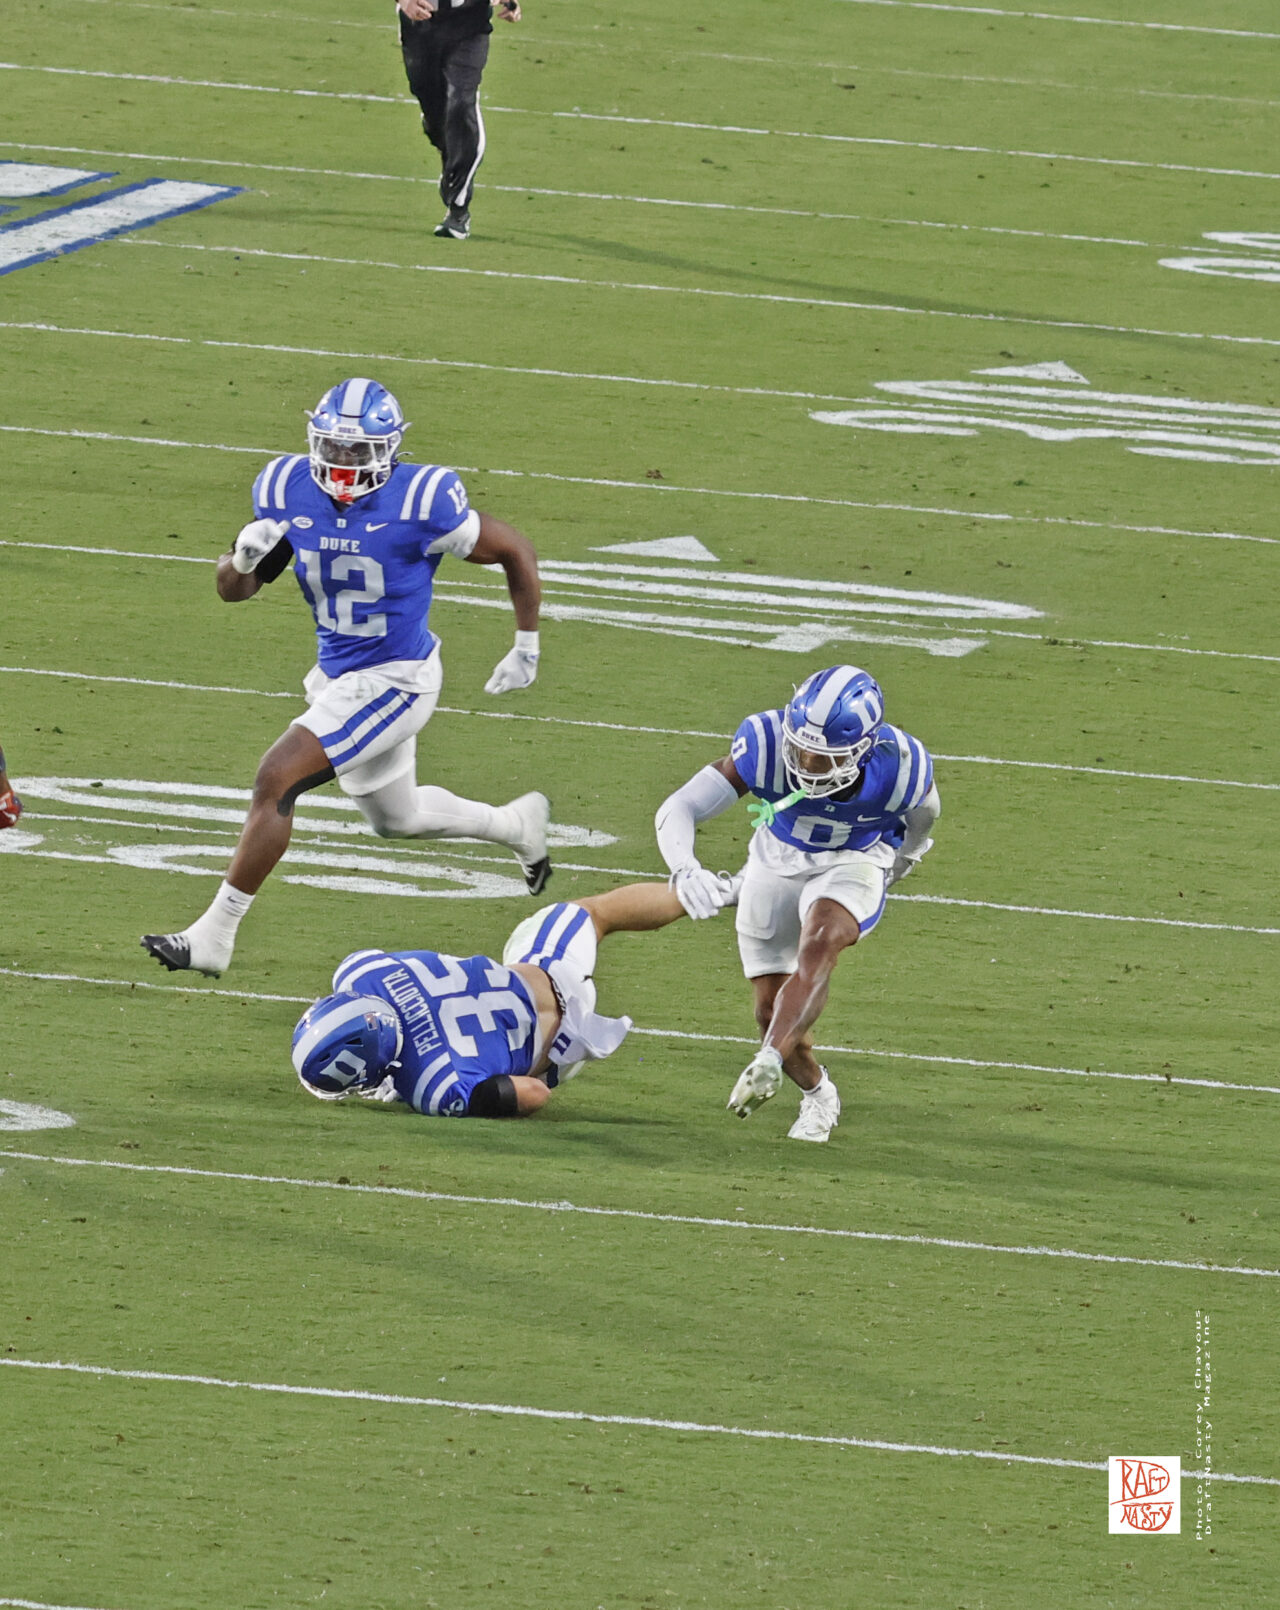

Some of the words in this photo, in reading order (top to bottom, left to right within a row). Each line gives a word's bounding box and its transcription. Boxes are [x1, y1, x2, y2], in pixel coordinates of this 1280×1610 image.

[319, 536, 361, 553] DUKE
[299, 548, 388, 637] 12
[850, 690, 883, 737] D
[801, 730, 821, 743] DUKE
[790, 815, 853, 848] 0
[382, 968, 442, 1057] PELLICCIOTTA
[400, 953, 532, 1058] 35
[552, 1033, 572, 1057] D
[320, 1049, 367, 1086] D
